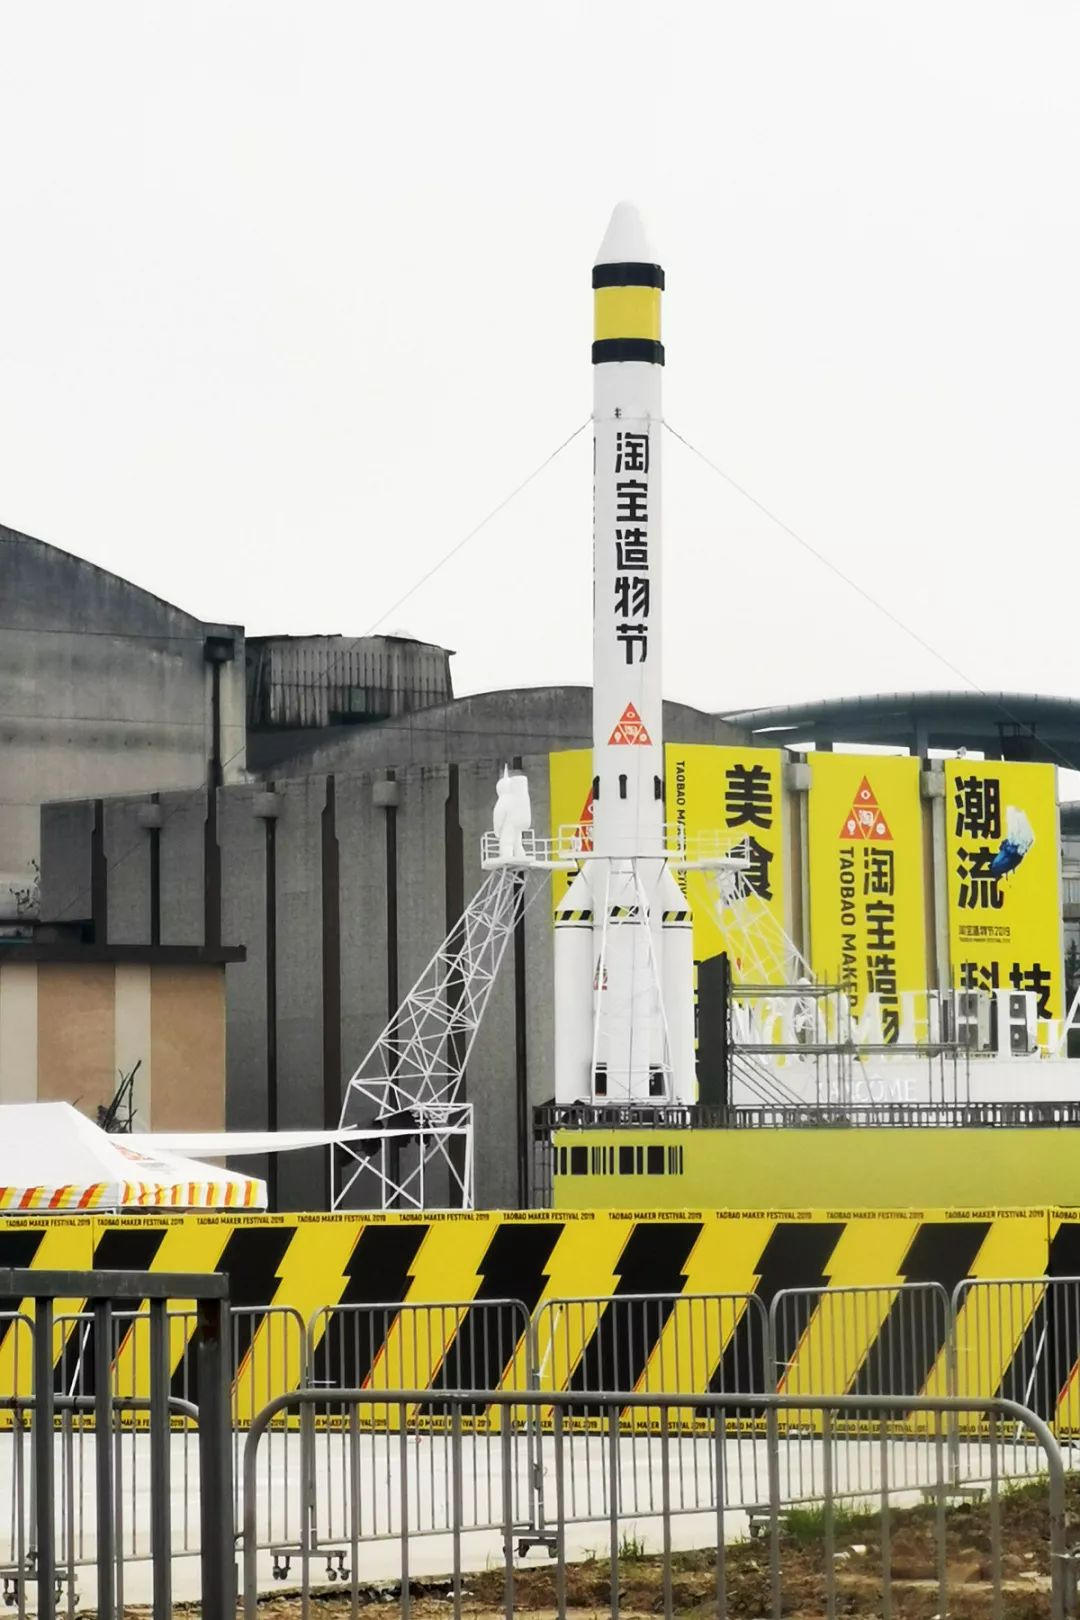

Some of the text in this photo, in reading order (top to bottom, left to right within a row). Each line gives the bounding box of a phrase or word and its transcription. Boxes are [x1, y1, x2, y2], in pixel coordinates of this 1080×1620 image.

[614, 432, 650, 665] 淘宝造物节
[676, 761, 686, 805] TAOBAO
[725, 764, 774, 905] 美食
[954, 776, 1004, 910] 潮流
[839, 847, 856, 927] TAOBAO
[961, 961, 1054, 1020] 科技
[476, 1213, 489, 1221] 2019
[581, 1212, 595, 1220] 2019
[609, 1212, 632, 1220] TAOBAO
[634, 1212, 656, 1220] MAKER
[658, 1212, 686, 1220] FESTIVAL
[716, 1212, 740, 1220] TAOBAO
[742, 1212, 764, 1220] MAKER
[767, 1212, 795, 1220] FESTIVAL
[945, 1211, 970, 1219] TAOBAO
[1029, 1210, 1044, 1218] 2019
[1052, 1211, 1077, 1219] TAOBAO
[29, 1219, 50, 1227] MAKER
[121, 1218, 142, 1226] MAKER
[143, 1218, 168, 1226] FESTIVAL
[221, 1217, 241, 1225] MAKER
[321, 1215, 342, 1223] MAKER
